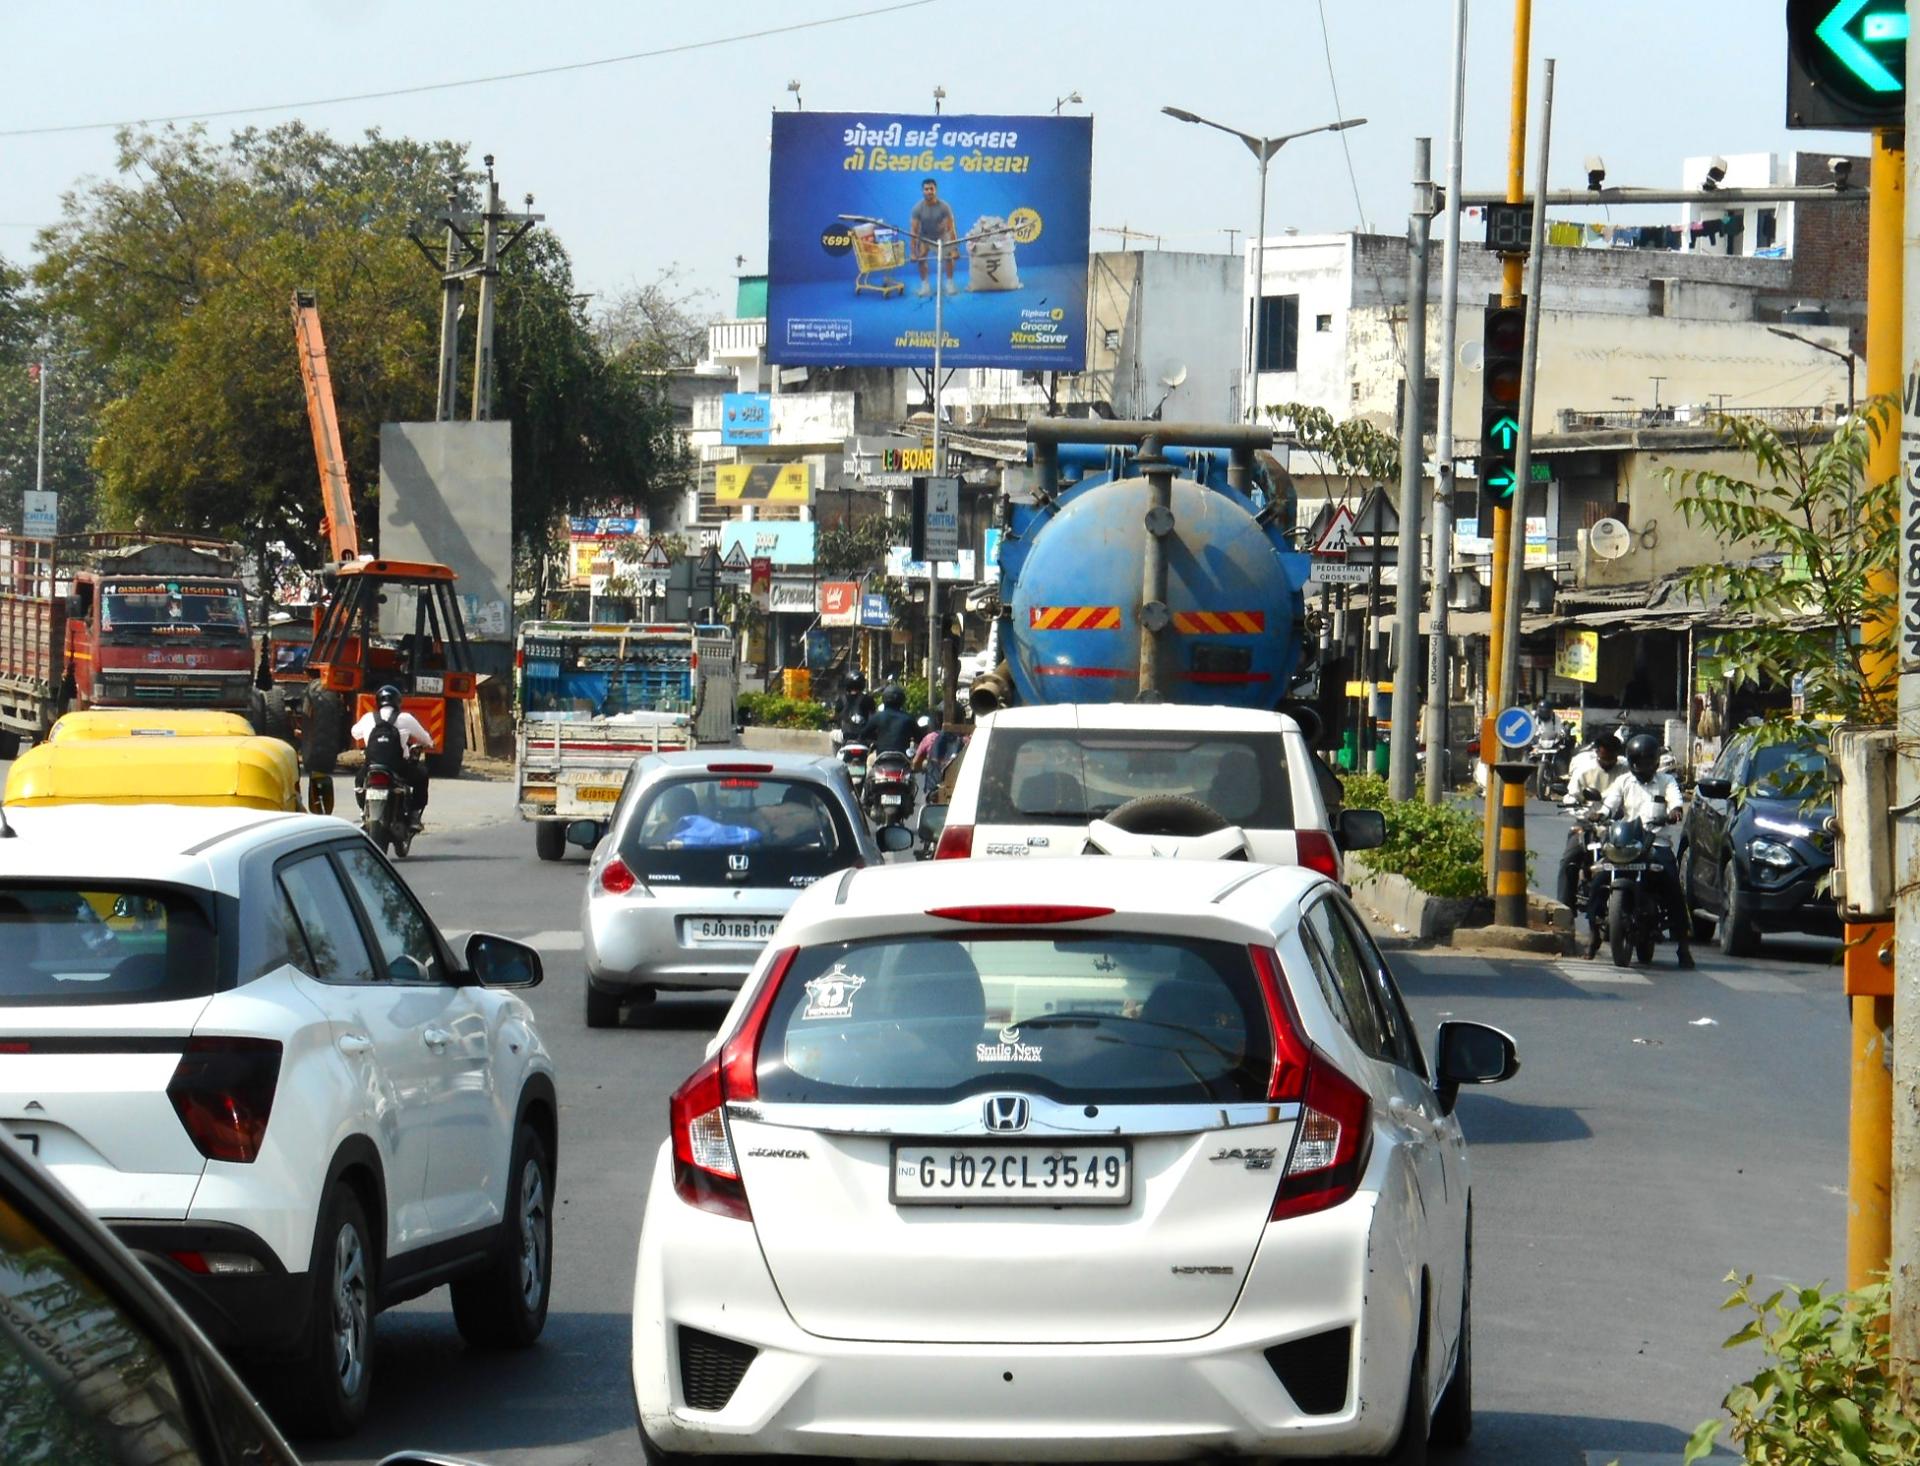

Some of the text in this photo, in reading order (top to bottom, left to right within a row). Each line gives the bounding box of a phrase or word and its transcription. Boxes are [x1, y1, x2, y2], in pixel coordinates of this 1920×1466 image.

[843, 122, 1018, 148] ગ્રોસરી કાર્ટ વજનદાર
[843, 148, 865, 170] તો
[869, 147, 955, 171] ડિસ્કાઉન્ટ
[1021, 309, 1050, 318] Flipkart
[1021, 322, 1058, 333] Grocery
[1011, 332, 1068, 343] XtraSaver
[882, 448, 936, 471] LED BOAR
[928, 512, 956, 528] CHITRA
[1316, 565, 1365, 573] PEDESTRIAN
[1320, 573, 1361, 581] CROSSING
[648, 873, 681, 881] HONDA
[702, 921, 779, 937] GJ01RB104
[976, 1043, 1011, 1058] Smile
[1014, 1043, 1043, 1055] New
[748, 1148, 810, 1160] HONDA
[1208, 1147, 1278, 1160] JAZZ
[898, 1155, 1120, 1188] IND GJ02CL3549
